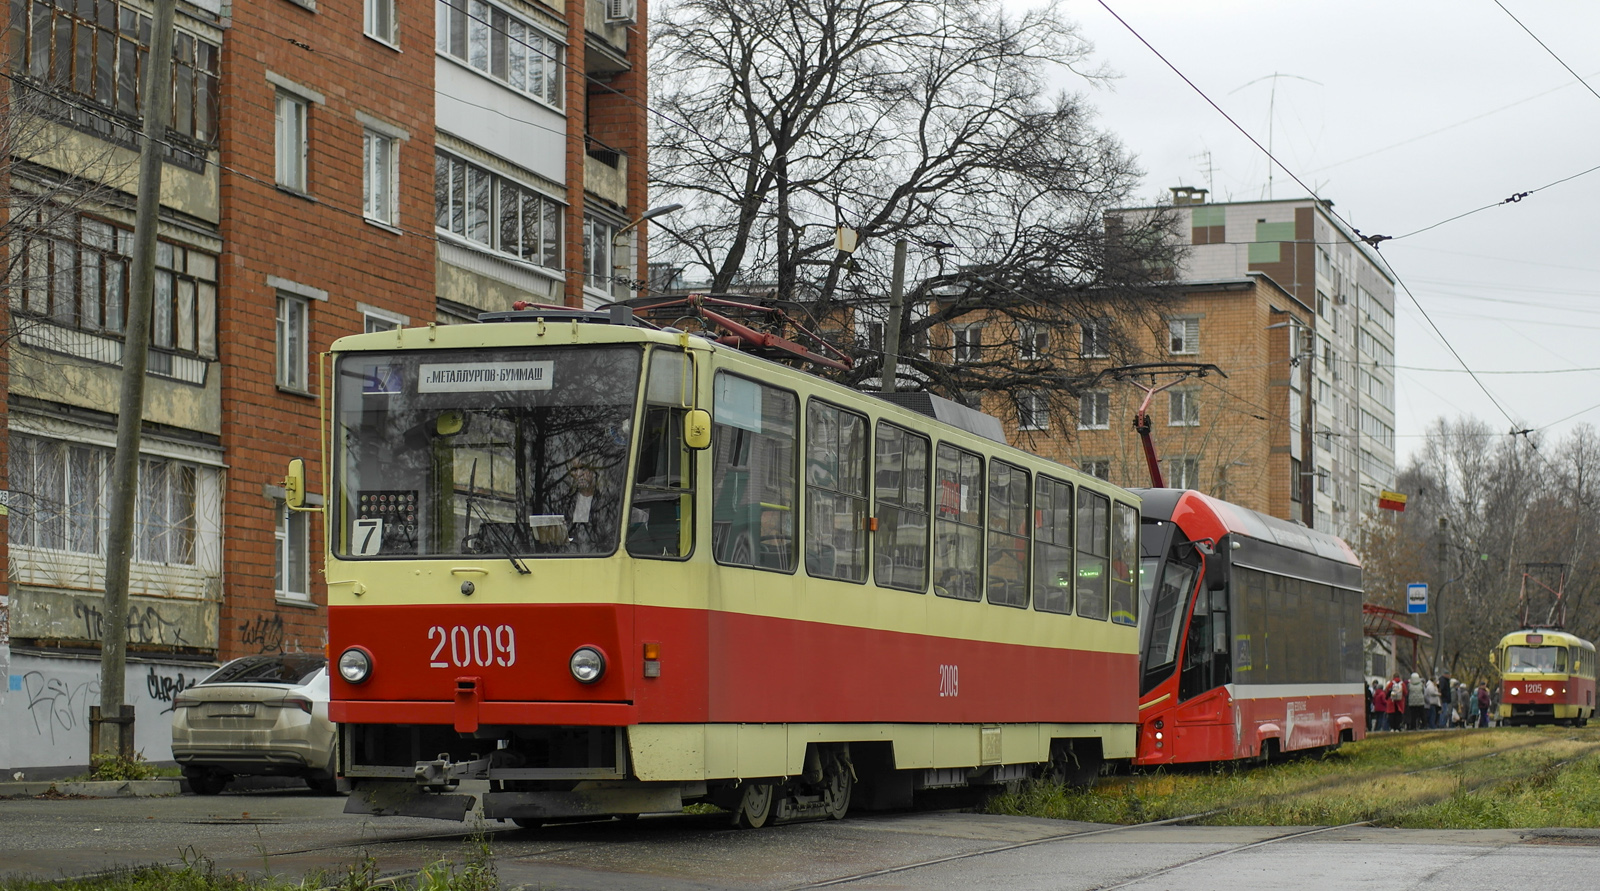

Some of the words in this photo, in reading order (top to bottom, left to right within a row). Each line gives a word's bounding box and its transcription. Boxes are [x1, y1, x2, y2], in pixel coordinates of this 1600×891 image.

[358, 521, 378, 554] 7
[427, 624, 516, 669] 2009
[939, 663, 959, 697] 2009
[1525, 683, 1542, 694] 1205
